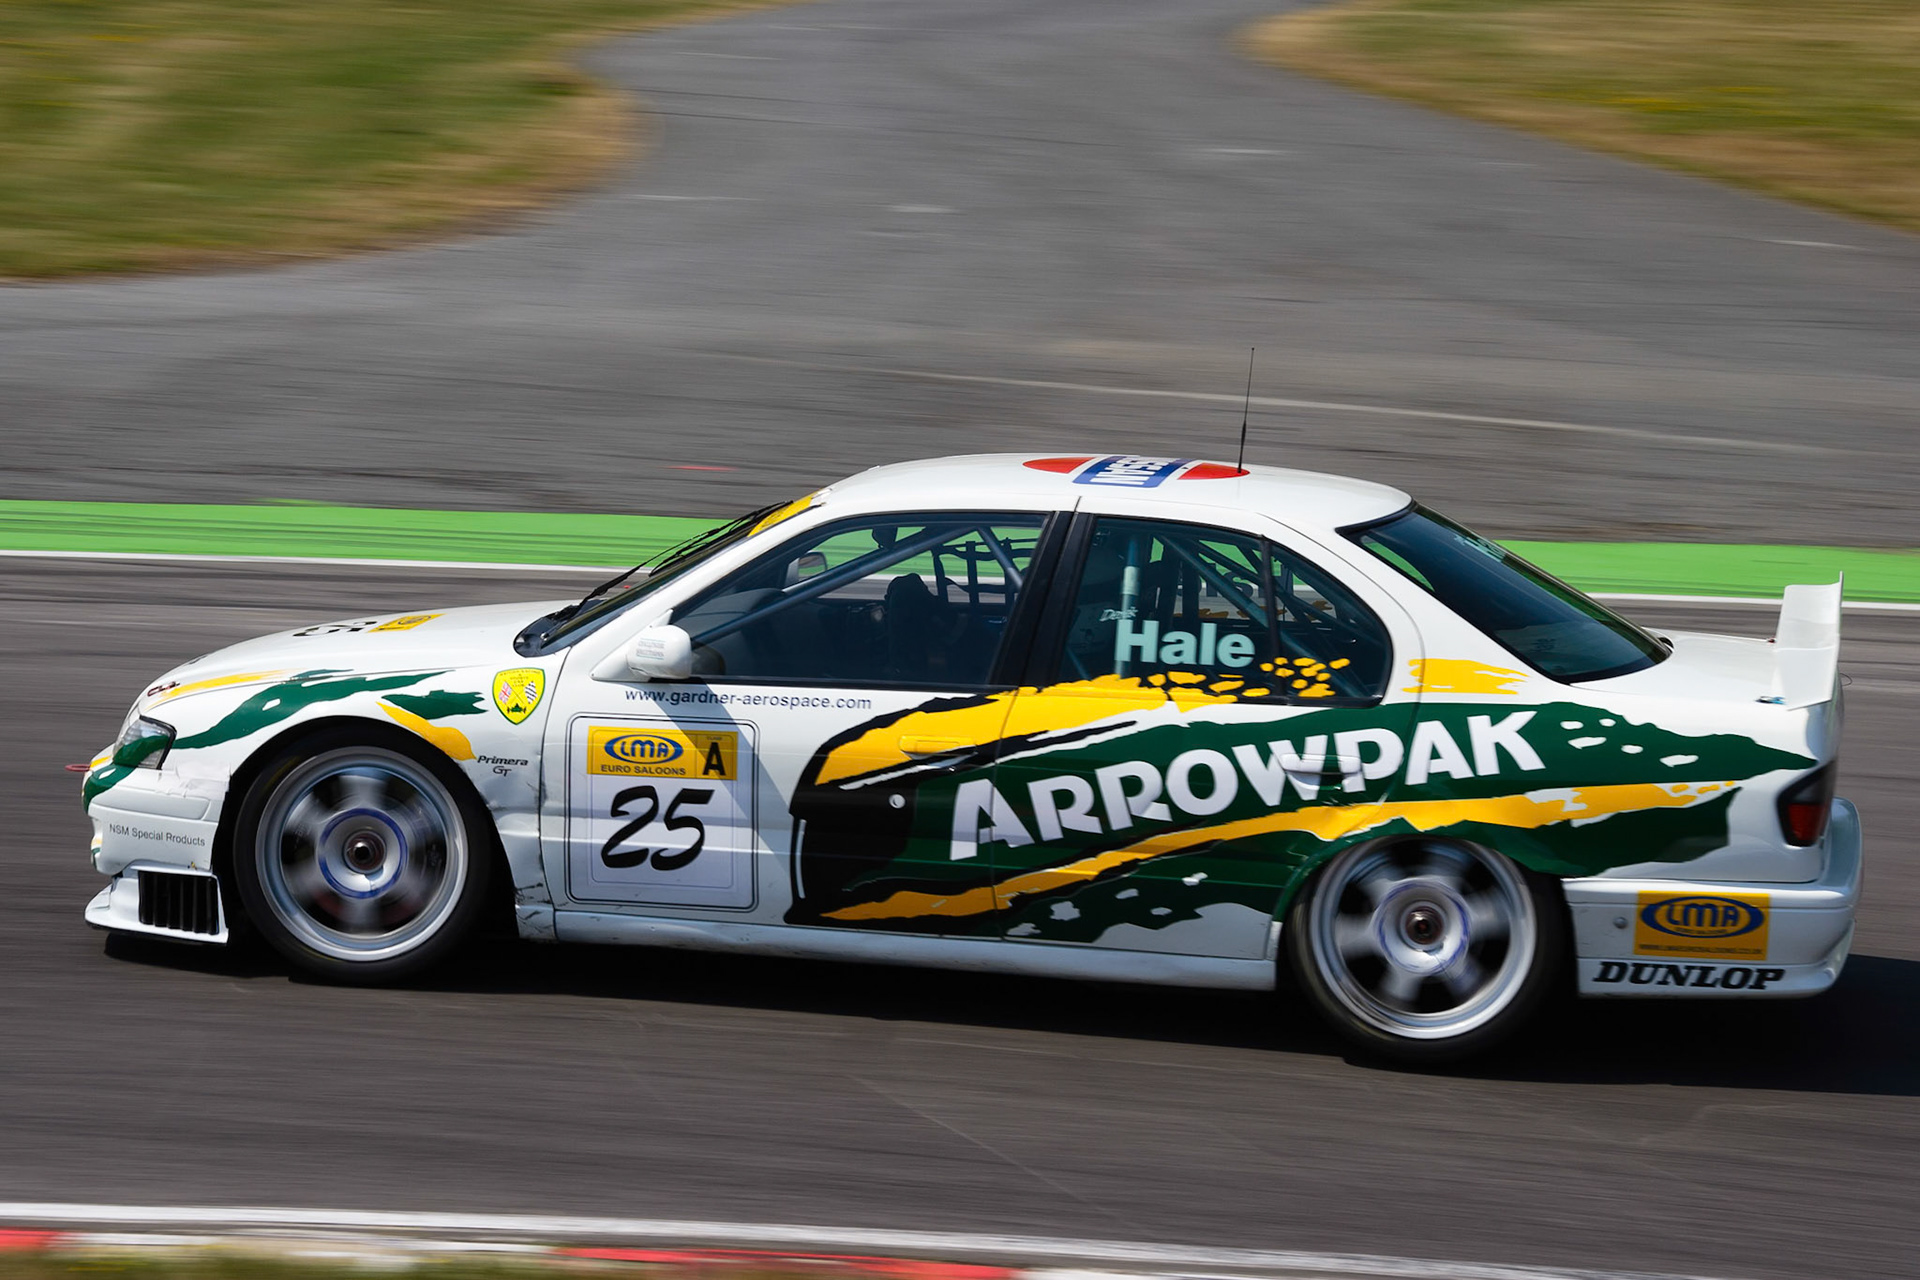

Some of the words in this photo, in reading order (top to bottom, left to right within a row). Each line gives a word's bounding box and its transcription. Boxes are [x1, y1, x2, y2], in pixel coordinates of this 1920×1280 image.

[1114, 619, 1256, 668] Hale
[625, 688, 872, 710] www.gardner-aerospace.com
[477, 755, 529, 766] Primera
[620, 739, 668, 758] LMA
[702, 742, 726, 776] A
[492, 765, 512, 777] GT
[600, 764, 631, 774] EURO
[634, 765, 686, 776] SALOONS
[949, 710, 1546, 861] ARROWPAK
[109, 823, 130, 836] NSM
[132, 827, 163, 841] Special
[601, 785, 715, 871] 25
[1666, 902, 1740, 928] LMA
[1592, 961, 1787, 991] DUNLOP
